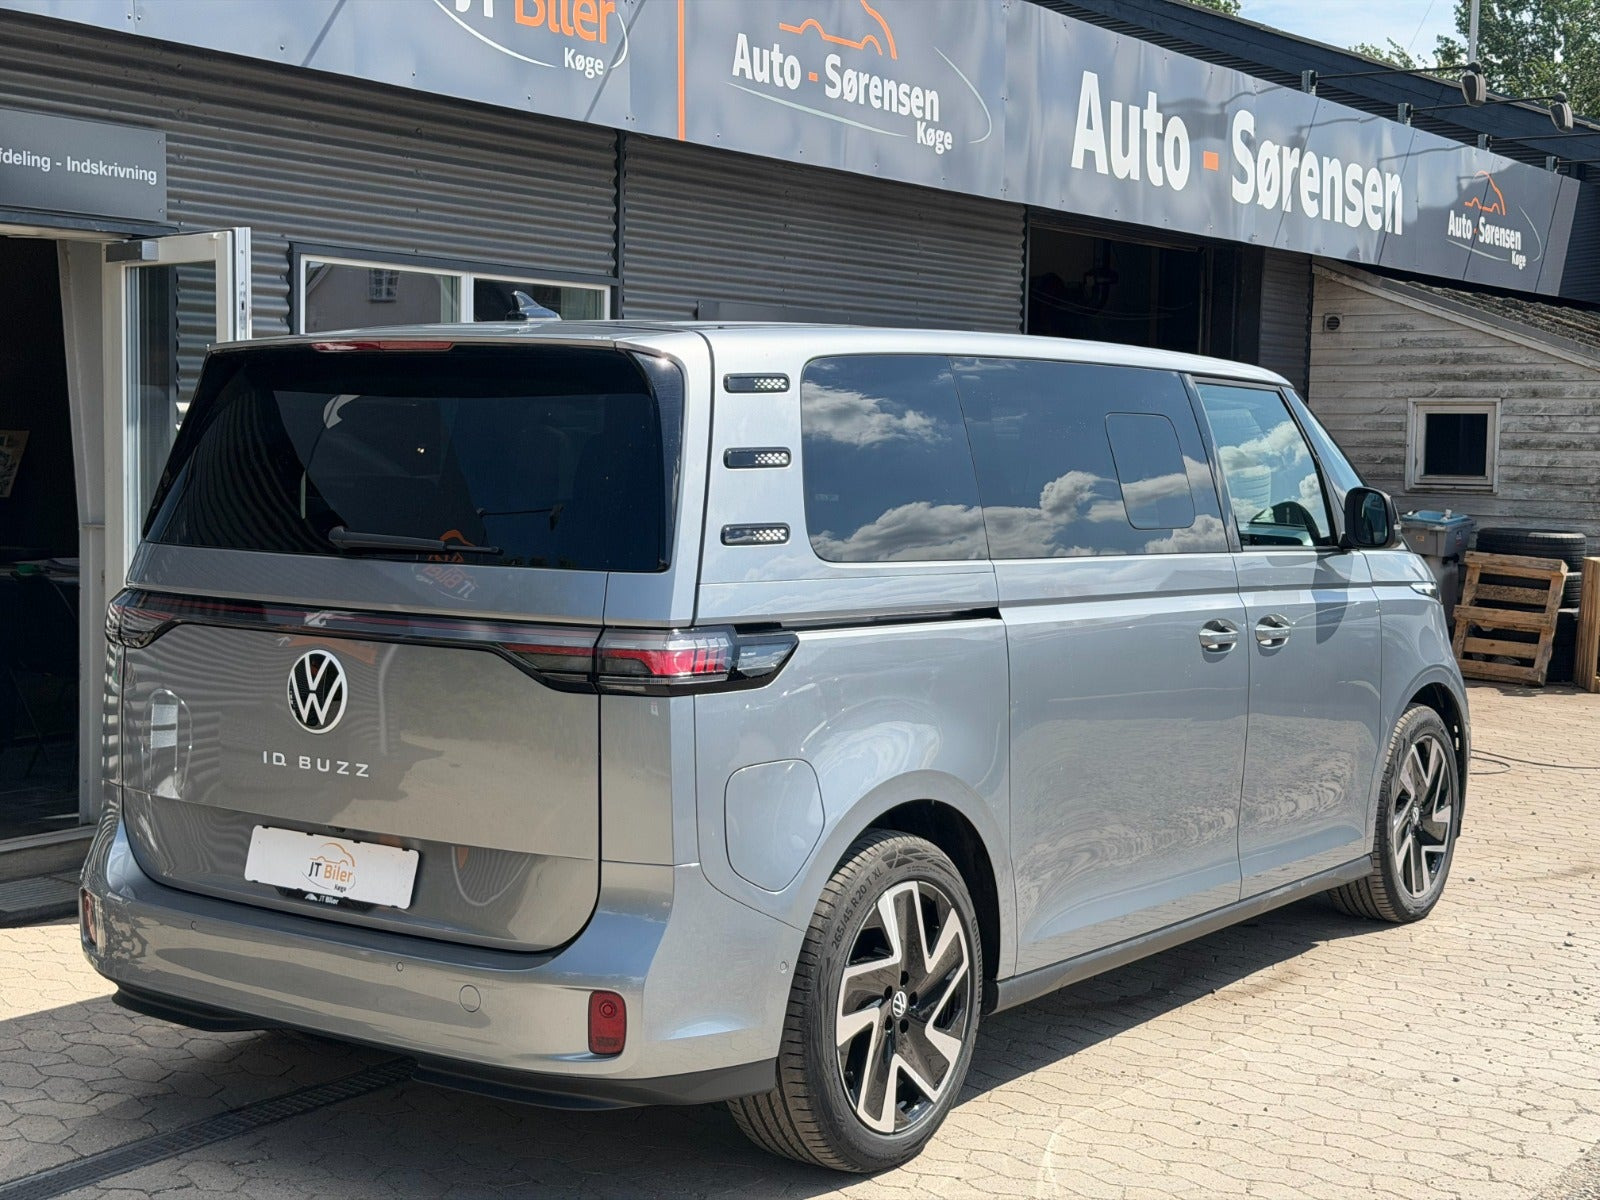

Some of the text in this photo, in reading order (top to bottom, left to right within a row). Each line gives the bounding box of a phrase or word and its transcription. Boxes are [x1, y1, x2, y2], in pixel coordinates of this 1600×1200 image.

[564, 47, 604, 79] Køge
[732, 32, 801, 90] Auto
[825, 53, 940, 122] Sørensen
[916, 121, 953, 155] Køge
[1070, 70, 1190, 191] Auto
[1231, 109, 1402, 235] Sørensen
[66, 156, 157, 185] Indskrivning
[1447, 210, 1473, 240] Auto
[1478, 216, 1521, 250] Sørensen
[1511, 250, 1527, 270] Køge
[299, 755, 369, 777] BUZZ
[308, 861, 353, 883] JT Biler
[831, 906, 853, 950] 265/45
